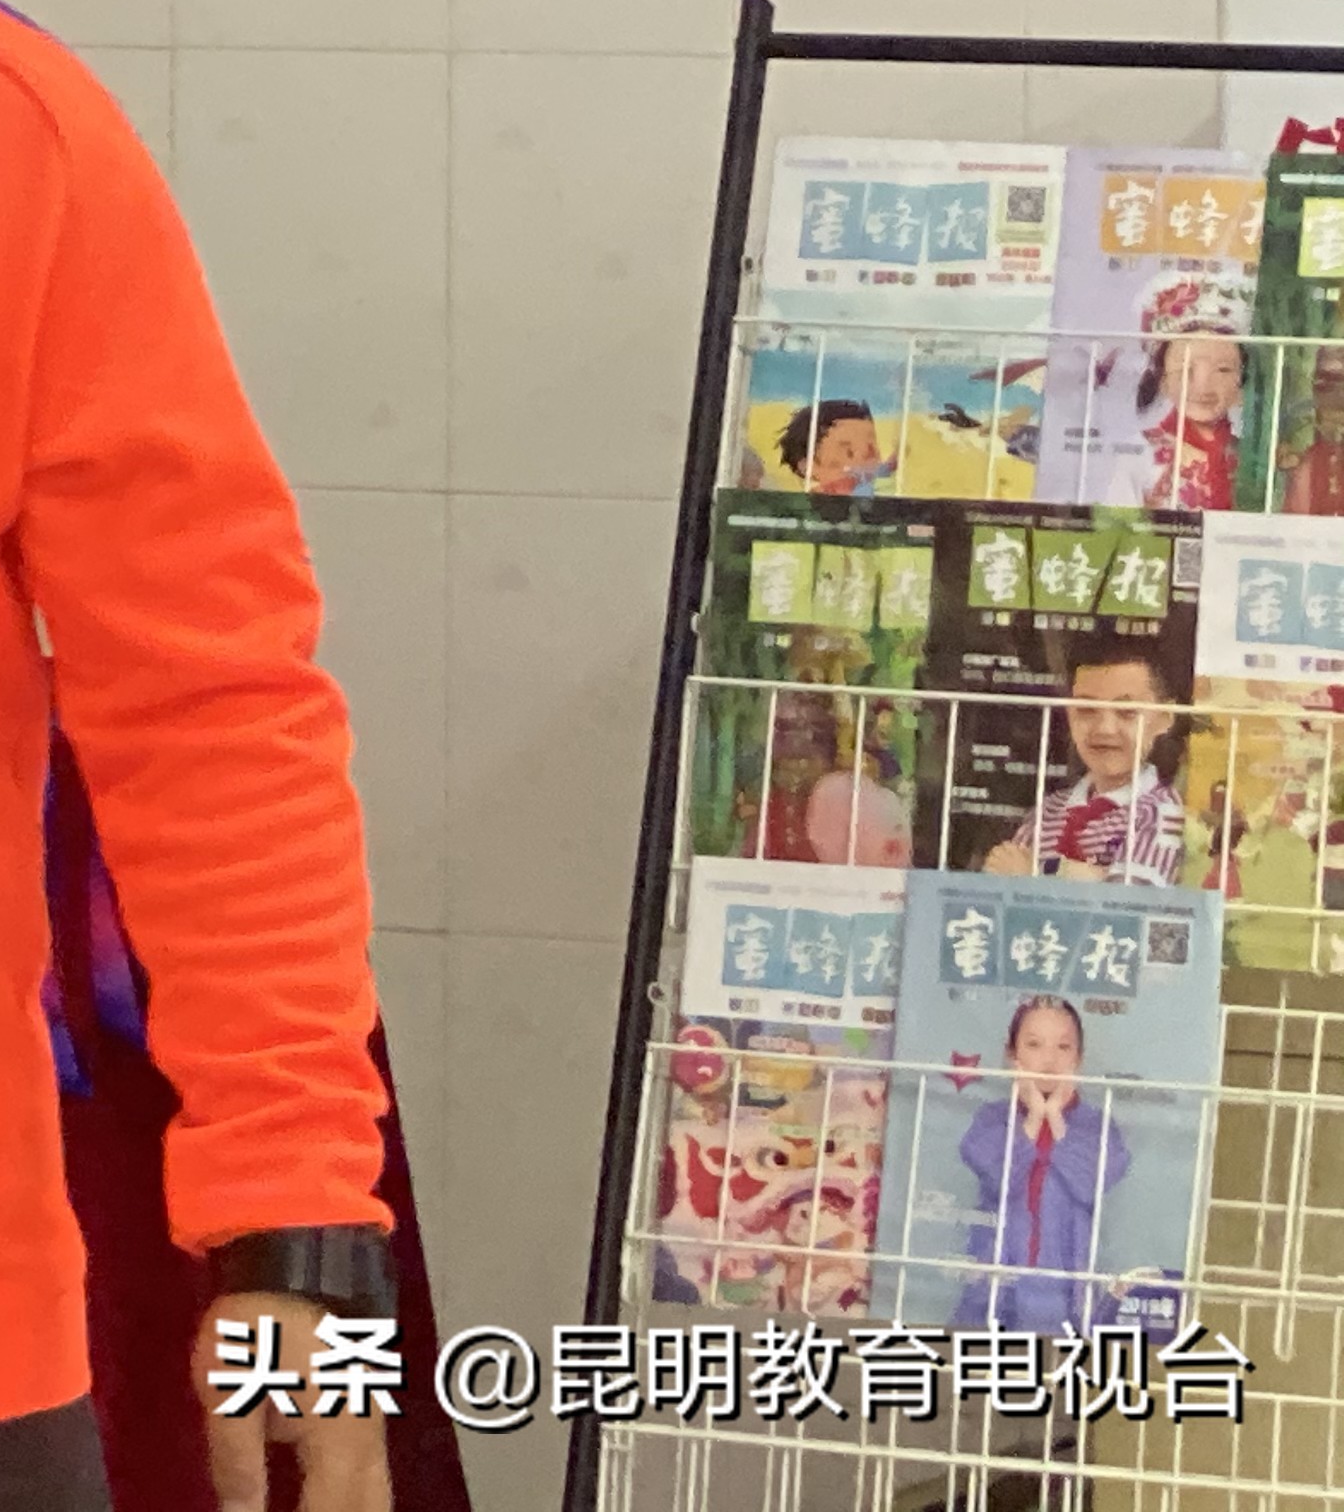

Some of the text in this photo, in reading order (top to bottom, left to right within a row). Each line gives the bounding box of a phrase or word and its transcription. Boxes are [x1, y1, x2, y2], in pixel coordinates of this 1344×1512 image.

[976, 531, 1167, 608] 蜜蜂报
[946, 906, 1138, 988] 蜜蜂报
